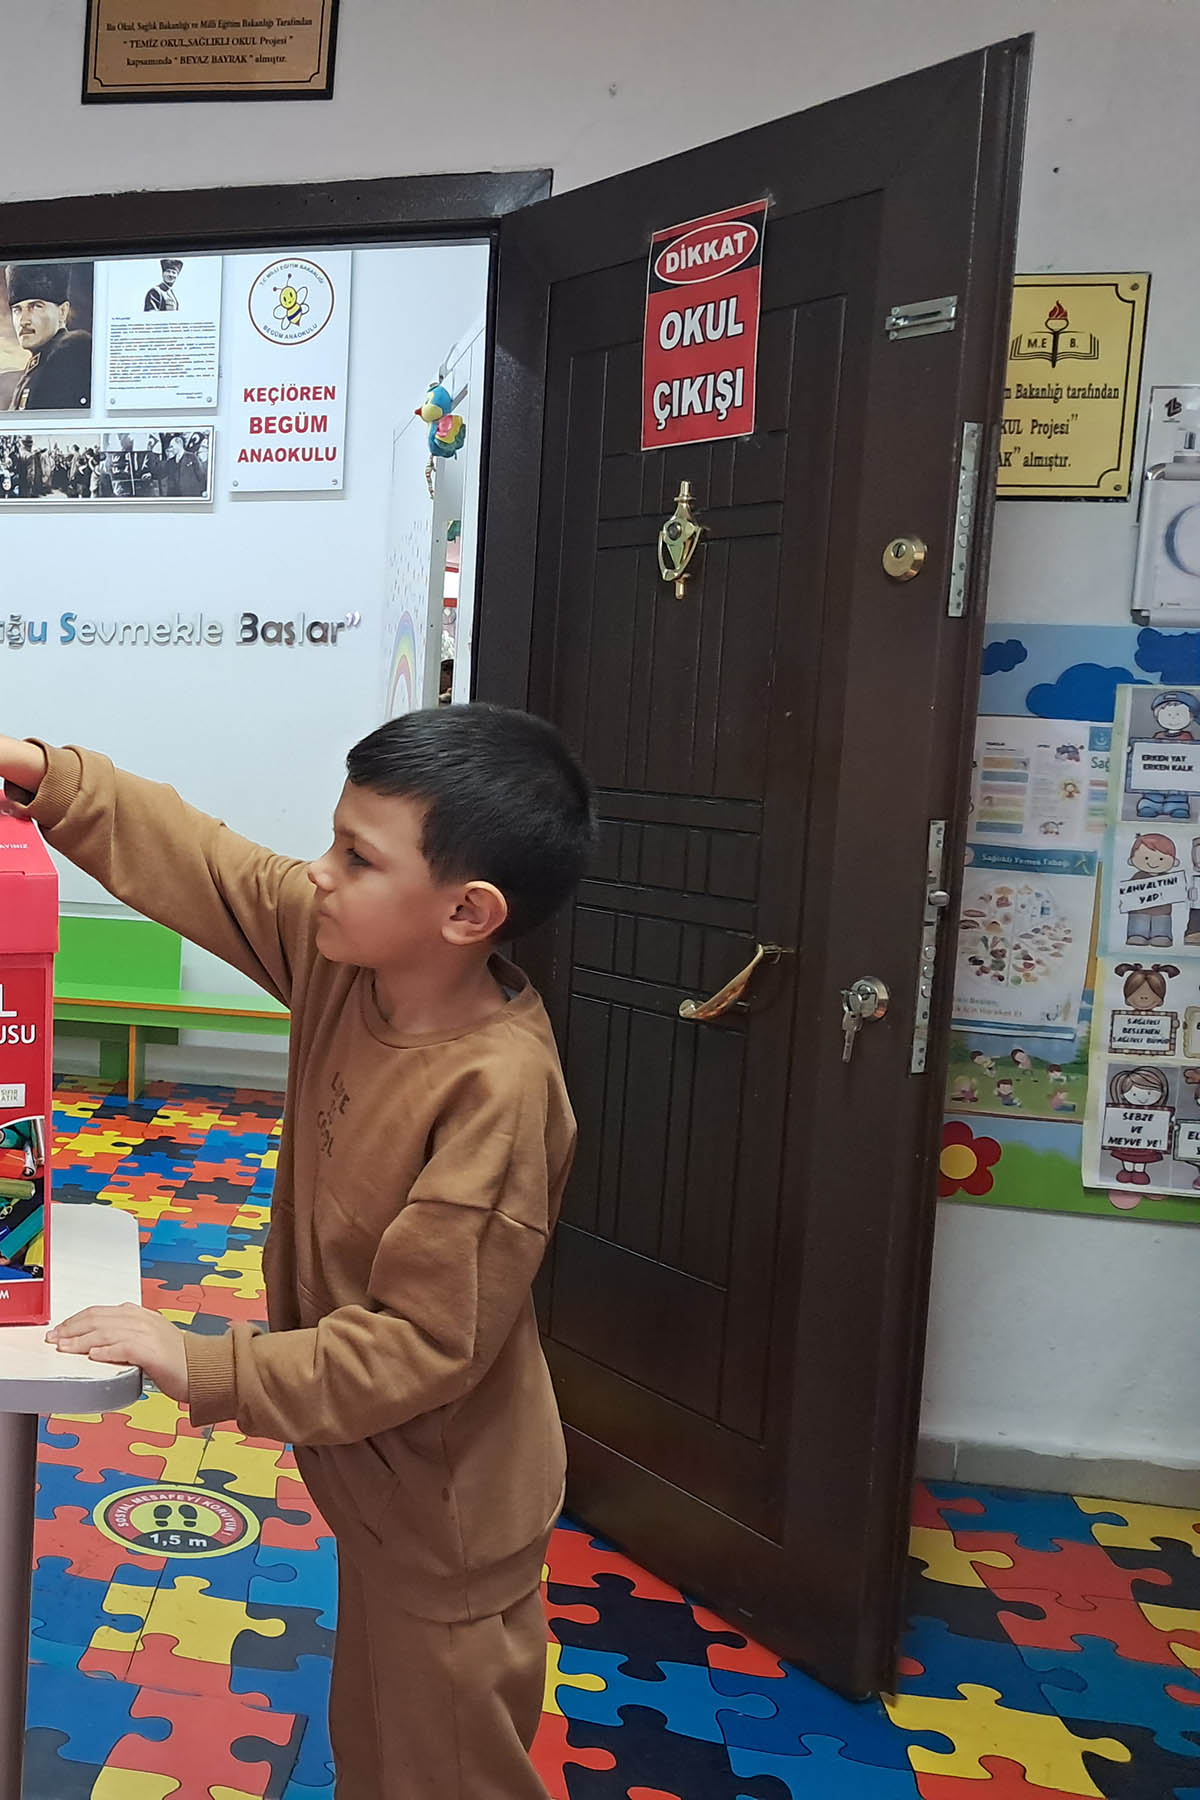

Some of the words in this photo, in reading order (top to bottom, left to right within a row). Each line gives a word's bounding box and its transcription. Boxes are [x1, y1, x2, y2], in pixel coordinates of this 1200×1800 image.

[231, 37, 257, 46] OKUL
[664, 230, 748, 274] DİKKAT
[659, 296, 745, 350] OKUL
[243, 383, 336, 406] KEÇİÖREN
[653, 367, 745, 431] ÇIKIŞI
[1015, 384, 1063, 404] Bakanlığı
[1066, 384, 1120, 400] tarafından
[249, 411, 328, 434] BEGÜM
[1000, 418, 1024, 435] KUL
[237, 446, 337, 463] ANAOKULU
[60, 611, 224, 647] Sevmekle
[1131, 1126, 1144, 1134] VE
[1108, 1136, 1142, 1147] MEYVE
[113, 1502, 135, 1528] SOSYAL
[150, 1533, 182, 1546] 1,5
[188, 1537, 208, 1547] m
